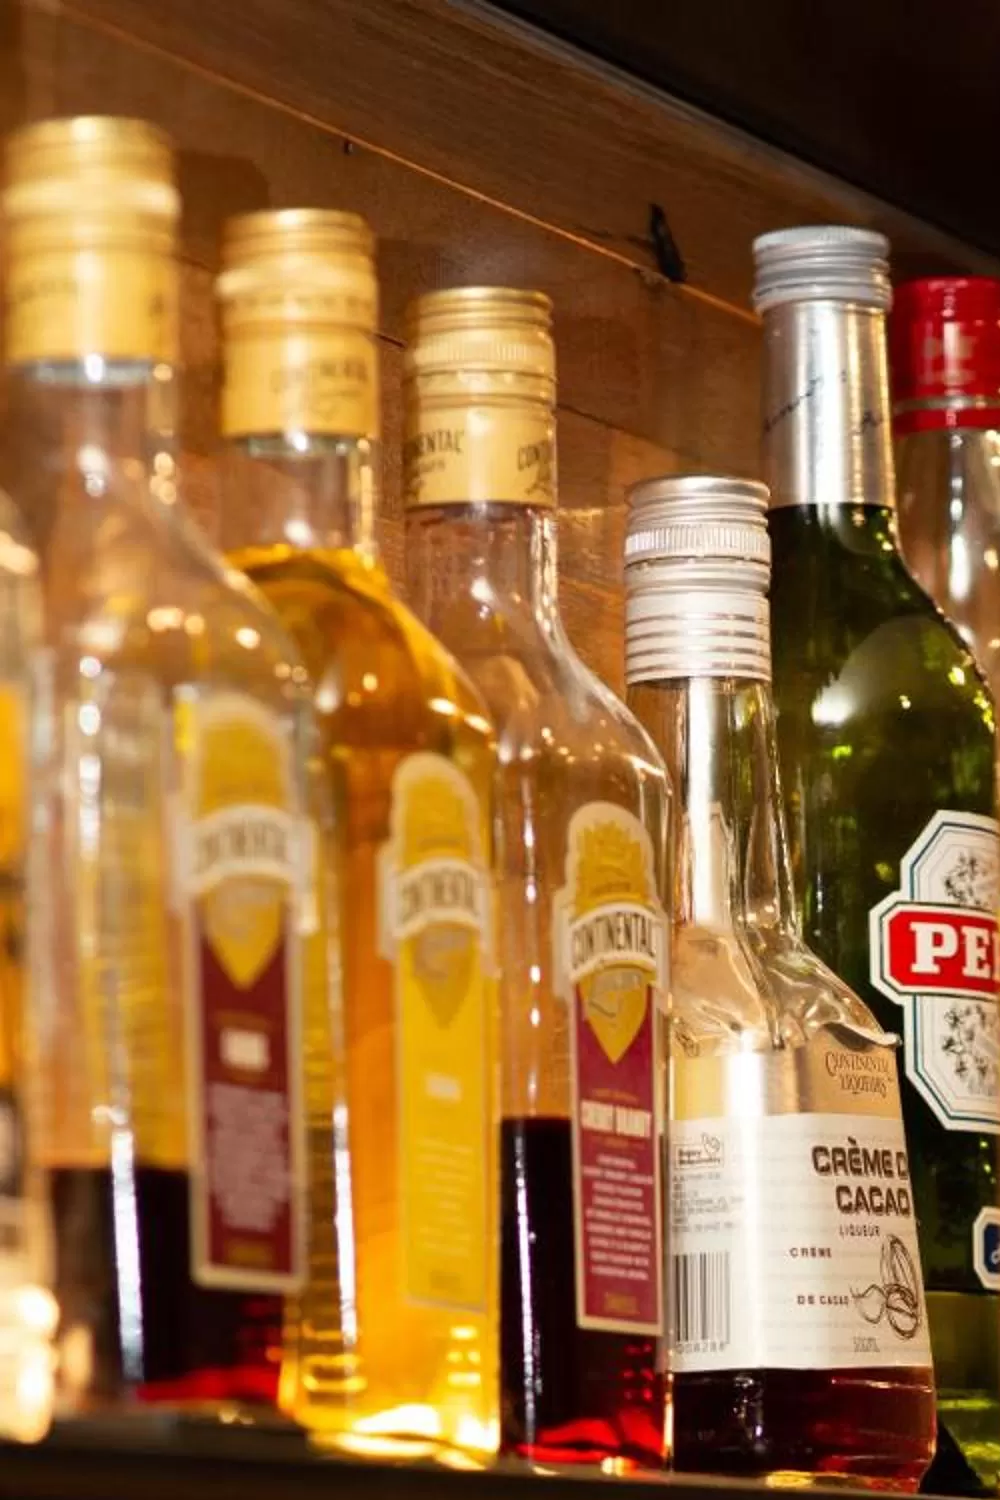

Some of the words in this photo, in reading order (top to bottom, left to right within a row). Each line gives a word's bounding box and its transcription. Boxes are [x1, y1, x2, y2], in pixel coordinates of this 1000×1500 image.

[909, 920, 1000, 980] PE
[812, 1137, 893, 1179] CRÈME
[839, 1223, 881, 1238] LIQUEUR
